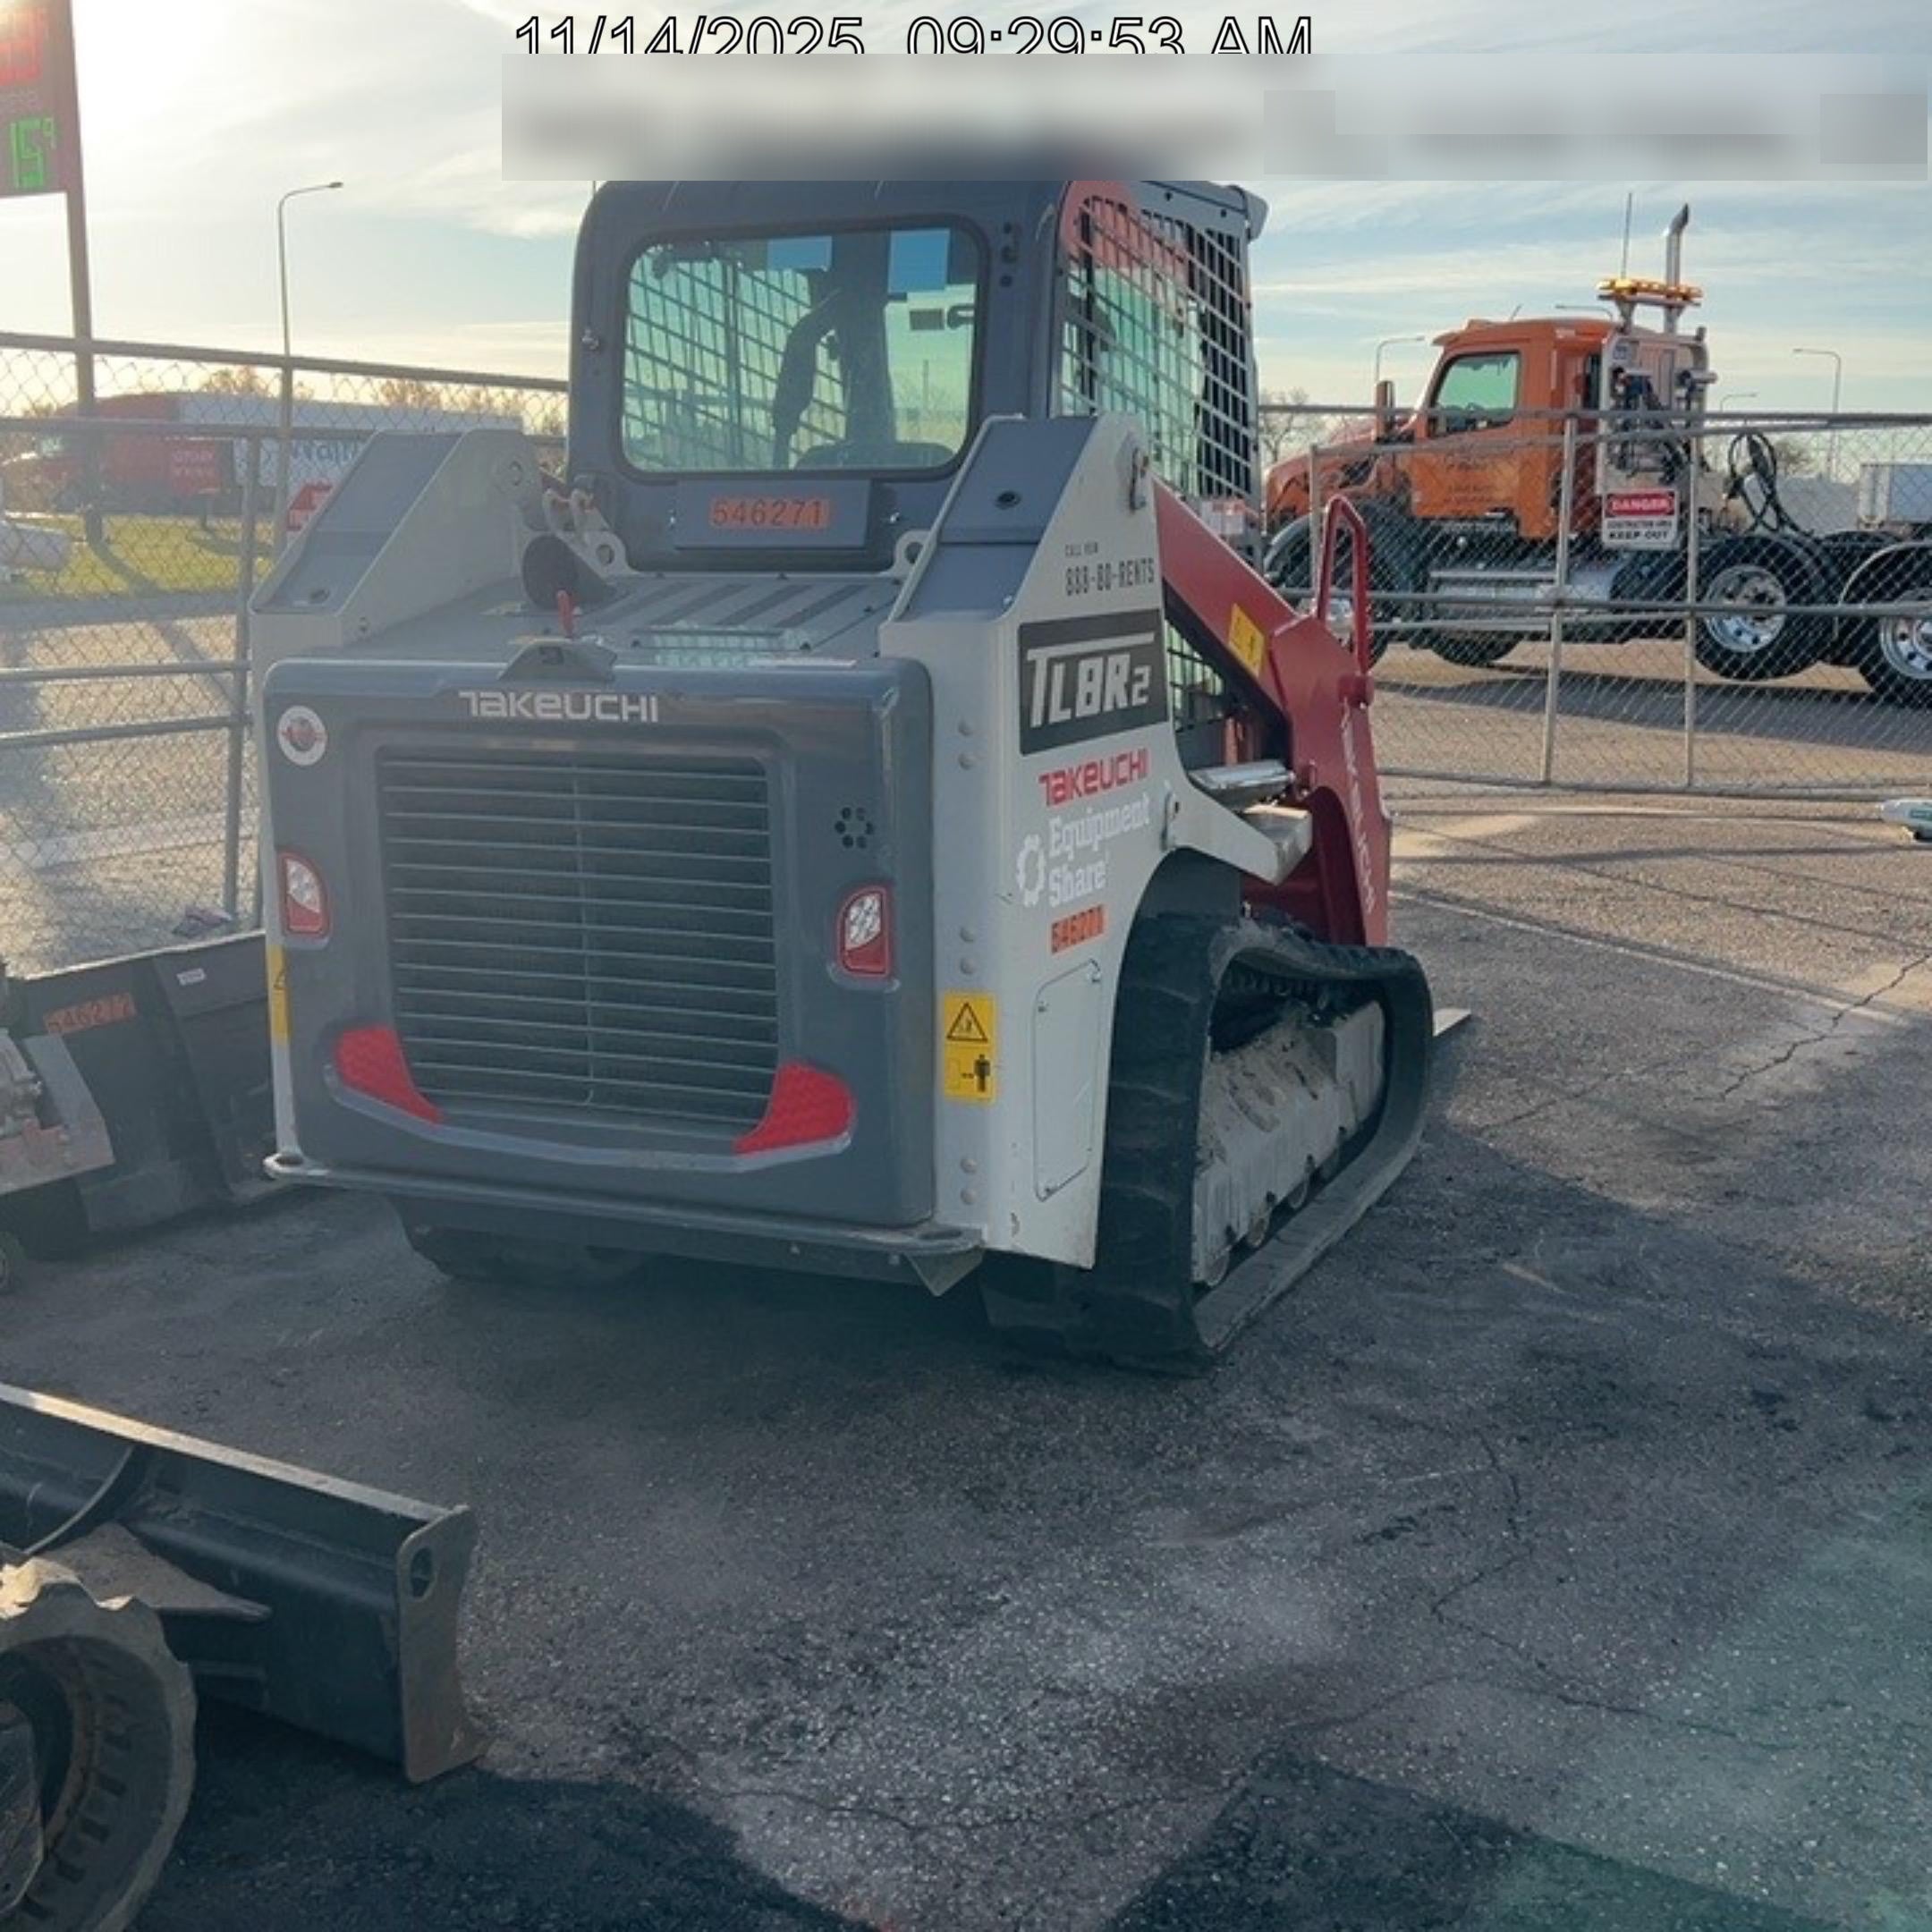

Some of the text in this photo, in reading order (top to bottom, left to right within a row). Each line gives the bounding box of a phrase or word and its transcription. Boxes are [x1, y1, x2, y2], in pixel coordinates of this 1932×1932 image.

[1612, 497, 1669, 512] DANGER
[1609, 530, 1668, 539] KEEP OUT
[1048, 792, 1151, 860] Equipment
[1047, 858, 1107, 908] Share
